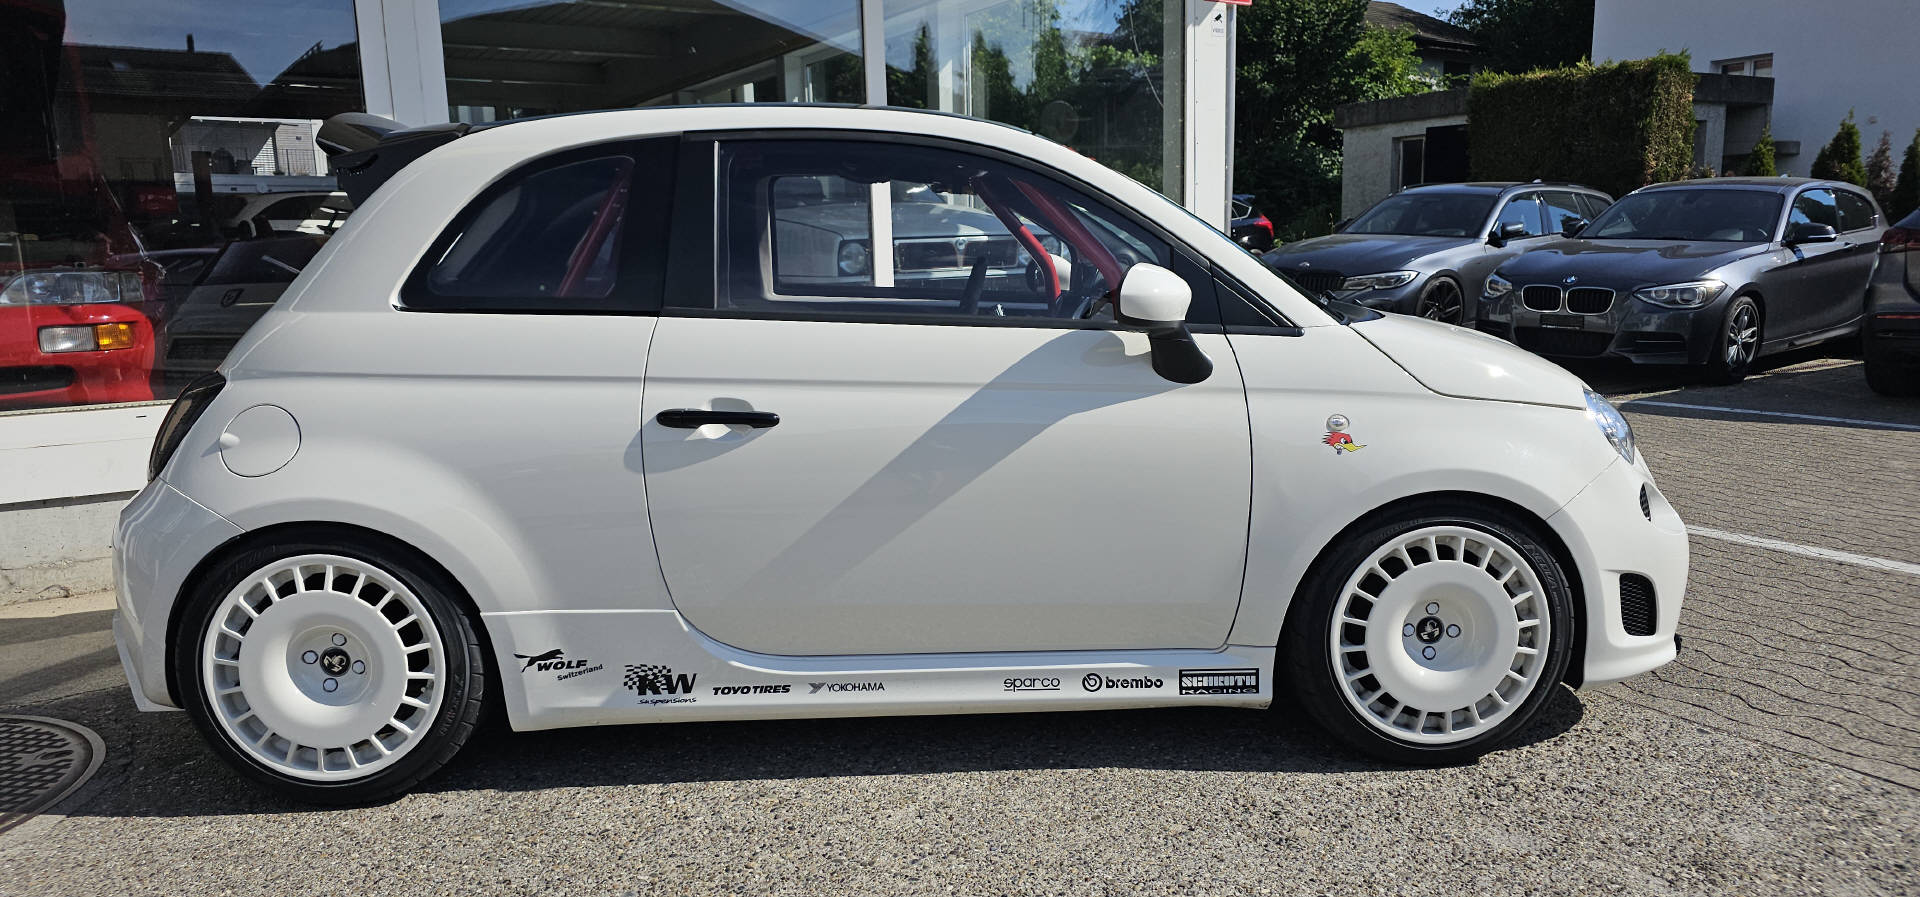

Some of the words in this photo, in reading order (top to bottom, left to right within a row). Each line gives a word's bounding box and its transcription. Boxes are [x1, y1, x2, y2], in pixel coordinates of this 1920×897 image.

[537, 659, 588, 672] WOLF
[557, 663, 603, 681] Switzerland
[637, 673, 698, 696] KW
[827, 682, 886, 692] YOKOHAMA
[1003, 677, 1061, 692] sparco
[1105, 676, 1164, 689] brembo
[712, 685, 751, 696] TOYO
[752, 684, 792, 694] TIRES
